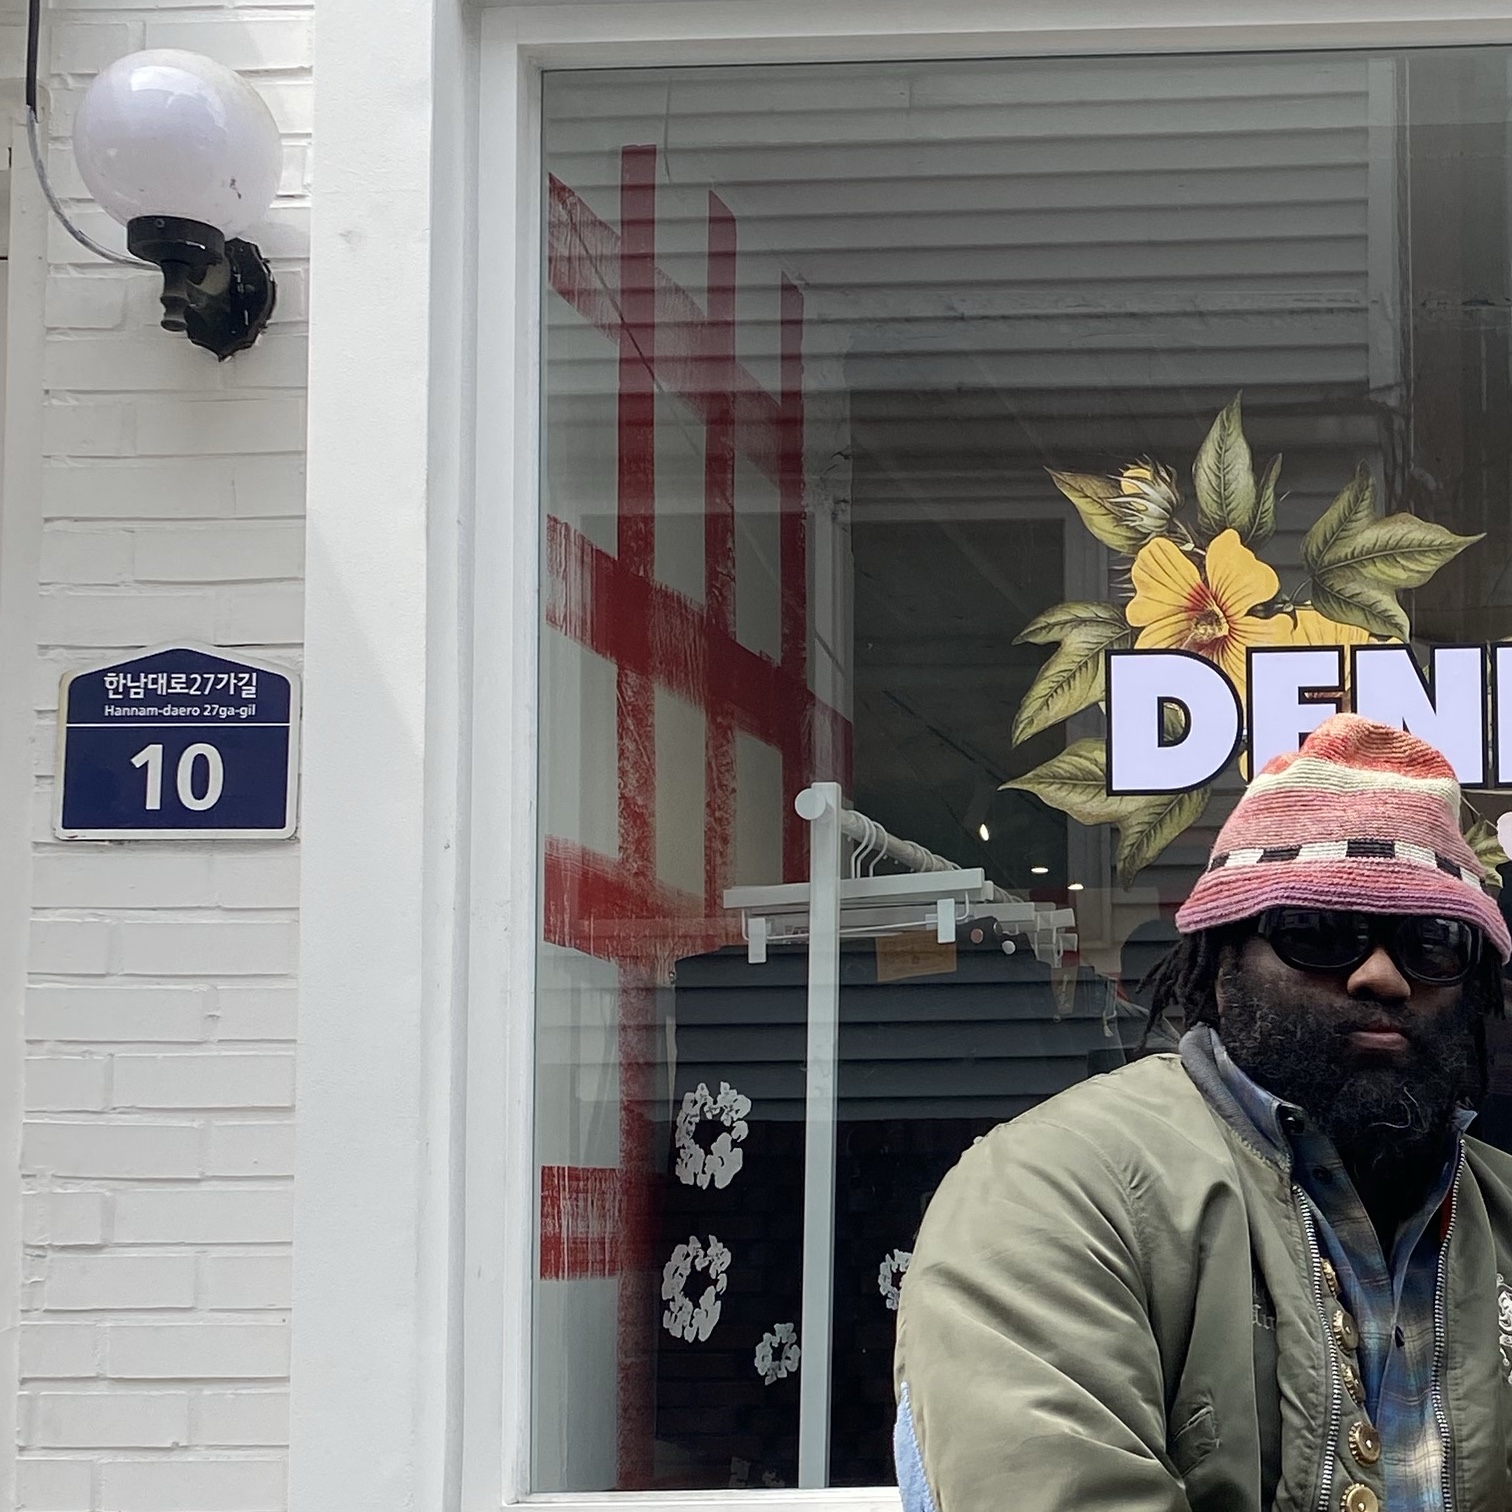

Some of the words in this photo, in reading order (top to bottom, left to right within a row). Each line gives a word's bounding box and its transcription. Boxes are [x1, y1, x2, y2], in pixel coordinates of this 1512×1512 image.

[103, 672, 257, 699] 한남대로27가길
[104, 704, 200, 717] Hannam-daero
[203, 703, 256, 719] 27ga-gil
[130, 742, 224, 812] 10
